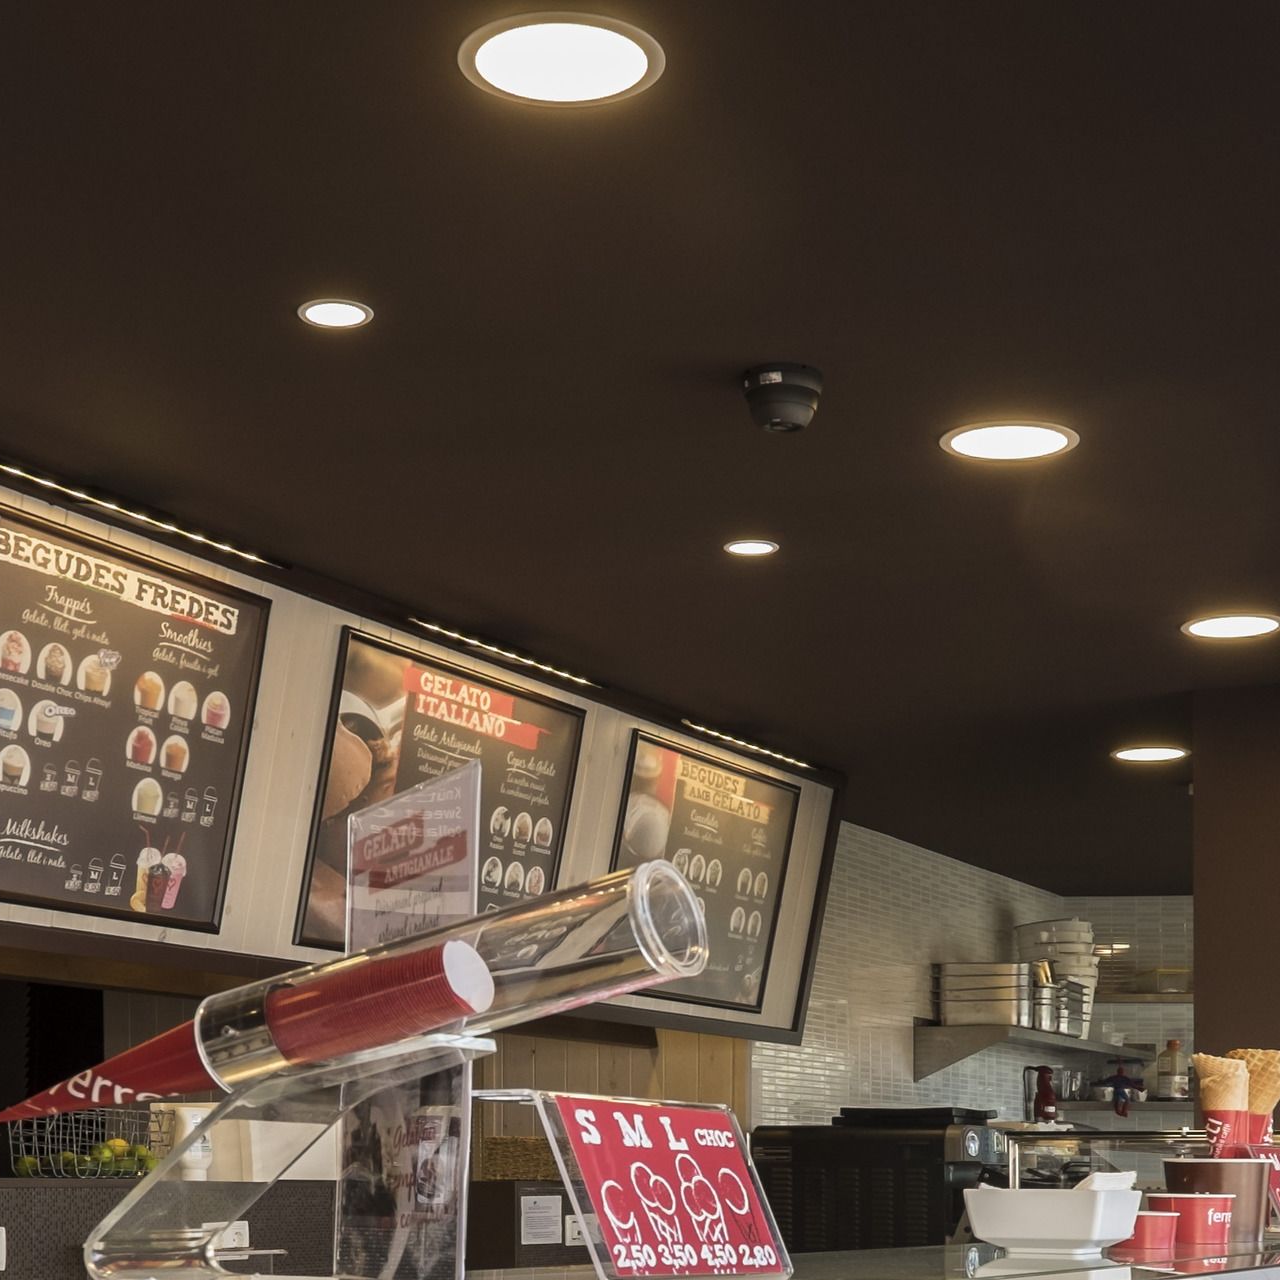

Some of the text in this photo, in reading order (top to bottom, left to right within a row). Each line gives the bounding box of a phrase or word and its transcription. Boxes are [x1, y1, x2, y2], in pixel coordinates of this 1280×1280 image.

[136, 577, 237, 630] FREDES
[159, 622, 214, 652] Smoothies
[420, 671, 492, 711] GELATO
[417, 693, 506, 738] ITALIANO
[681, 761, 740, 795] BEGUDES
[711, 791, 761, 821] GELATO
[0, 818, 69, 845] Milkshakes
[574, 1109, 735, 1150] S M L CHOC
[613, 1244, 777, 1270] 2,50 3,50 4,50 2,80
